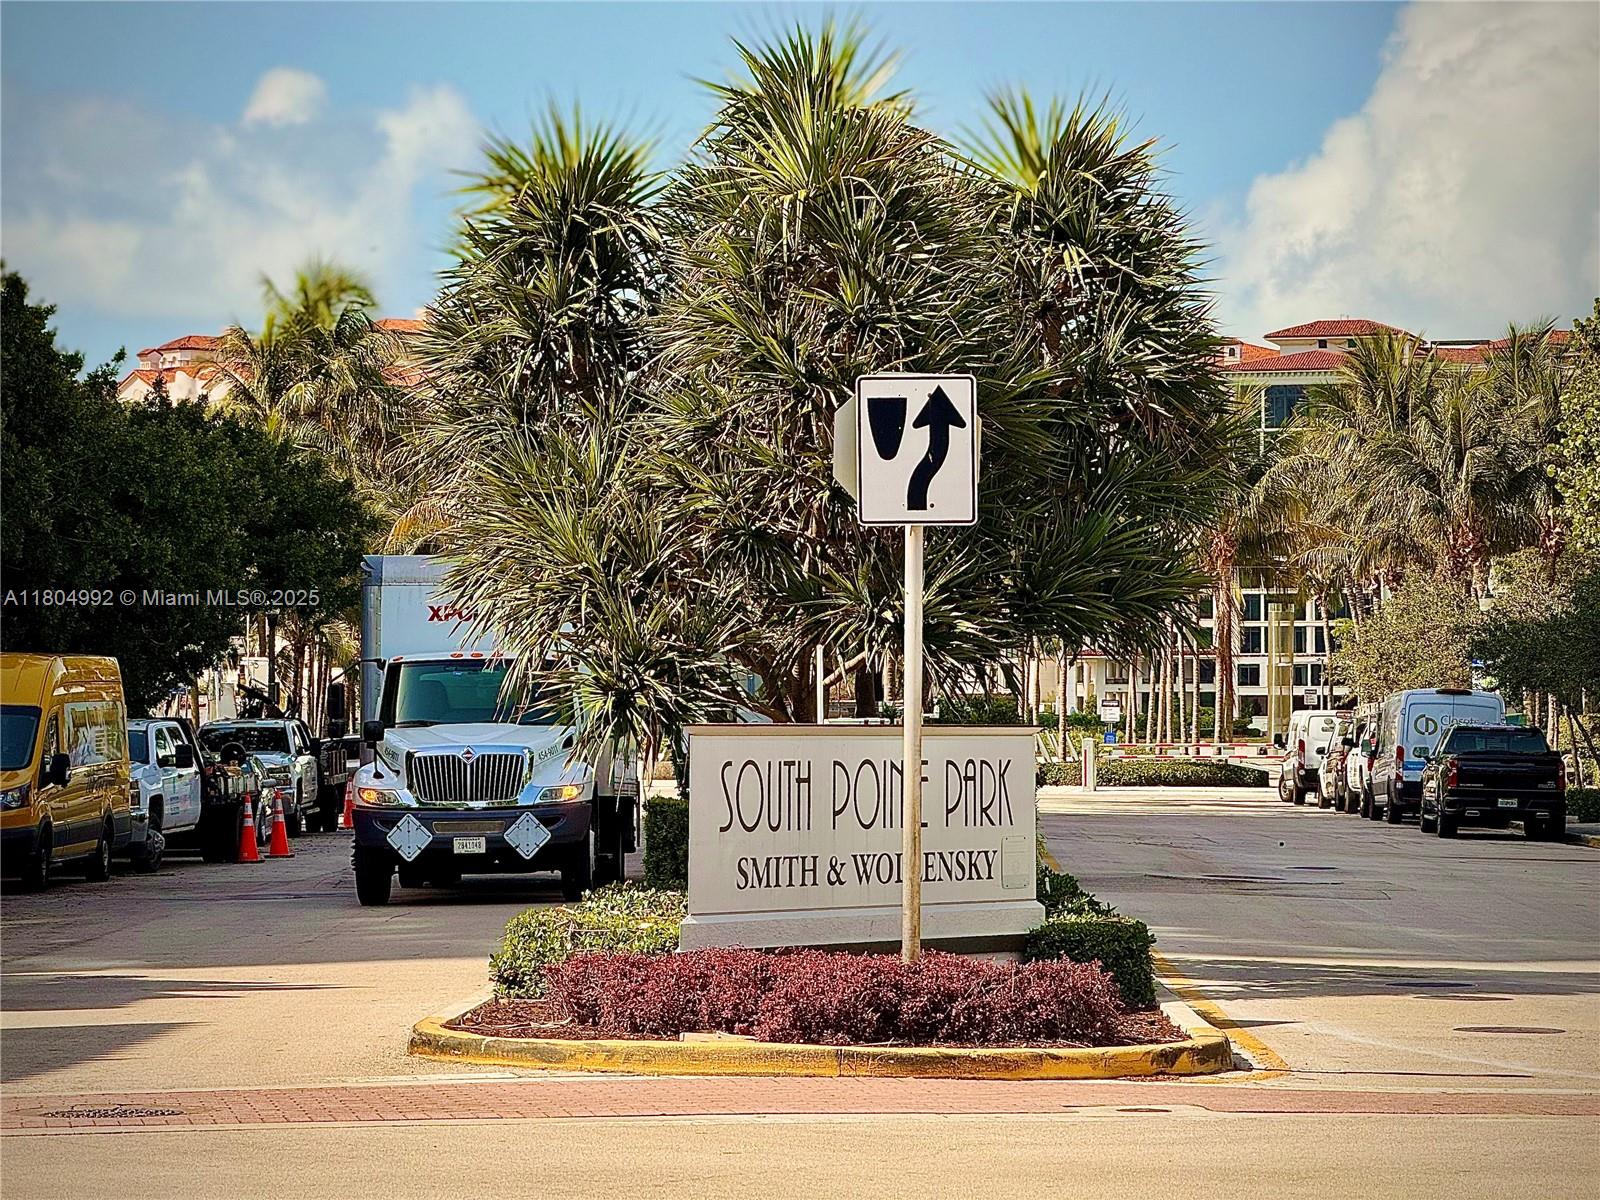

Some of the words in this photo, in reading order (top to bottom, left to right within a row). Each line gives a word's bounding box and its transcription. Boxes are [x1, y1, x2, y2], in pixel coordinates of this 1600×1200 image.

[719, 759, 812, 832] SOUTH
[833, 758, 929, 830] POINE
[945, 758, 1014, 828] PARK
[736, 855, 819, 890] SMITH
[826, 855, 847, 886] &
[850, 849, 998, 886] WOLENSKY
